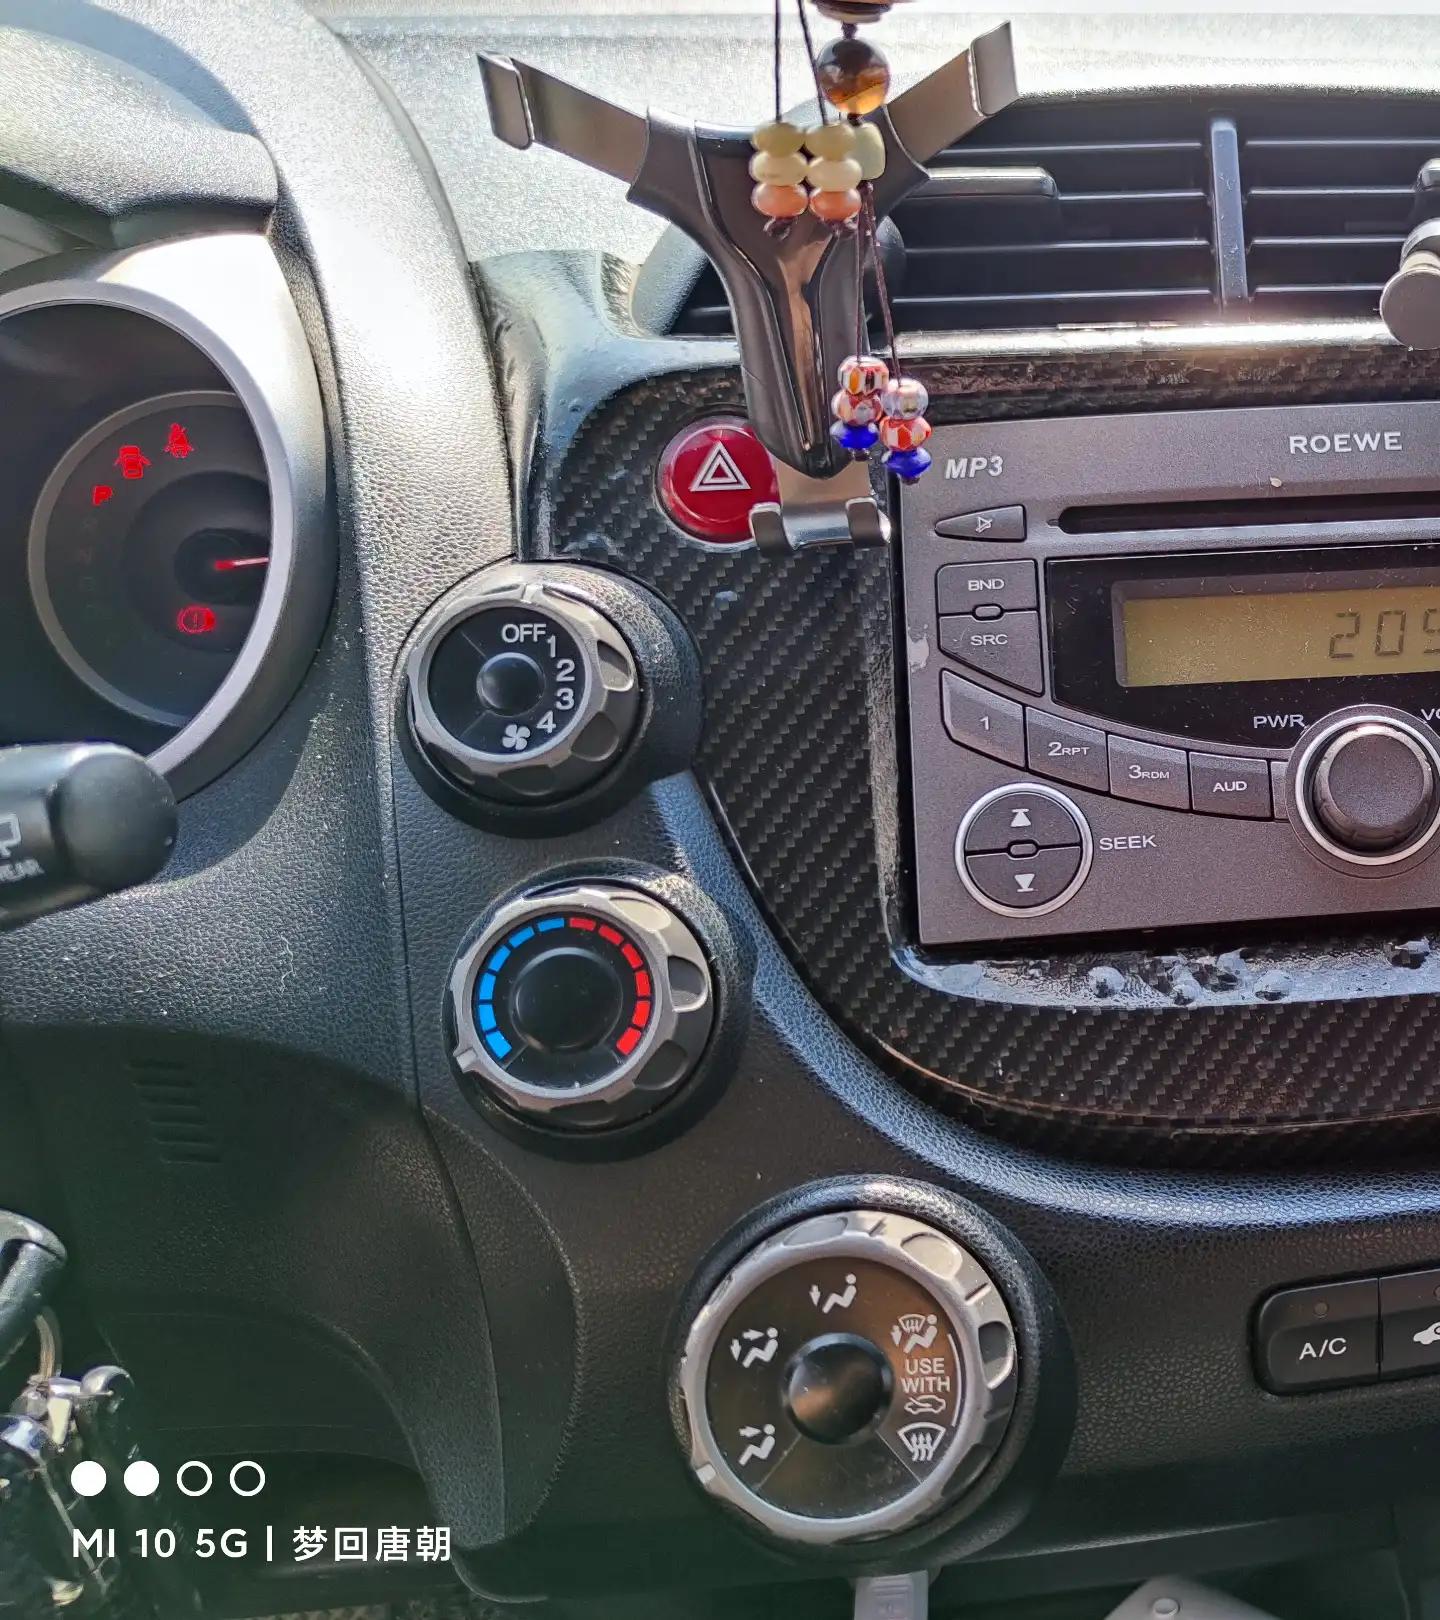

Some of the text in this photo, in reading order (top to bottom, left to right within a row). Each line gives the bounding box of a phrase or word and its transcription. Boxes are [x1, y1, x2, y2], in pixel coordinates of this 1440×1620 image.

[1289, 431, 1403, 455] ROEWE
[944, 454, 1004, 480] MP3
[967, 578, 1005, 592] BND
[502, 623, 547, 643] OFF
[970, 633, 1008, 646] SRC
[547, 635, 557, 658] 1
[556, 659, 575, 681] 2
[556, 688, 575, 710] 3
[536, 710, 557, 734] 4
[979, 716, 990, 731] 1
[1253, 714, 1306, 729] PWR
[1212, 780, 1248, 793] AUD
[1099, 834, 1158, 851] SEEK
[1299, 1337, 1347, 1361] A/C
[905, 1357, 945, 1375] USE
[900, 1375, 951, 1394] WITH
